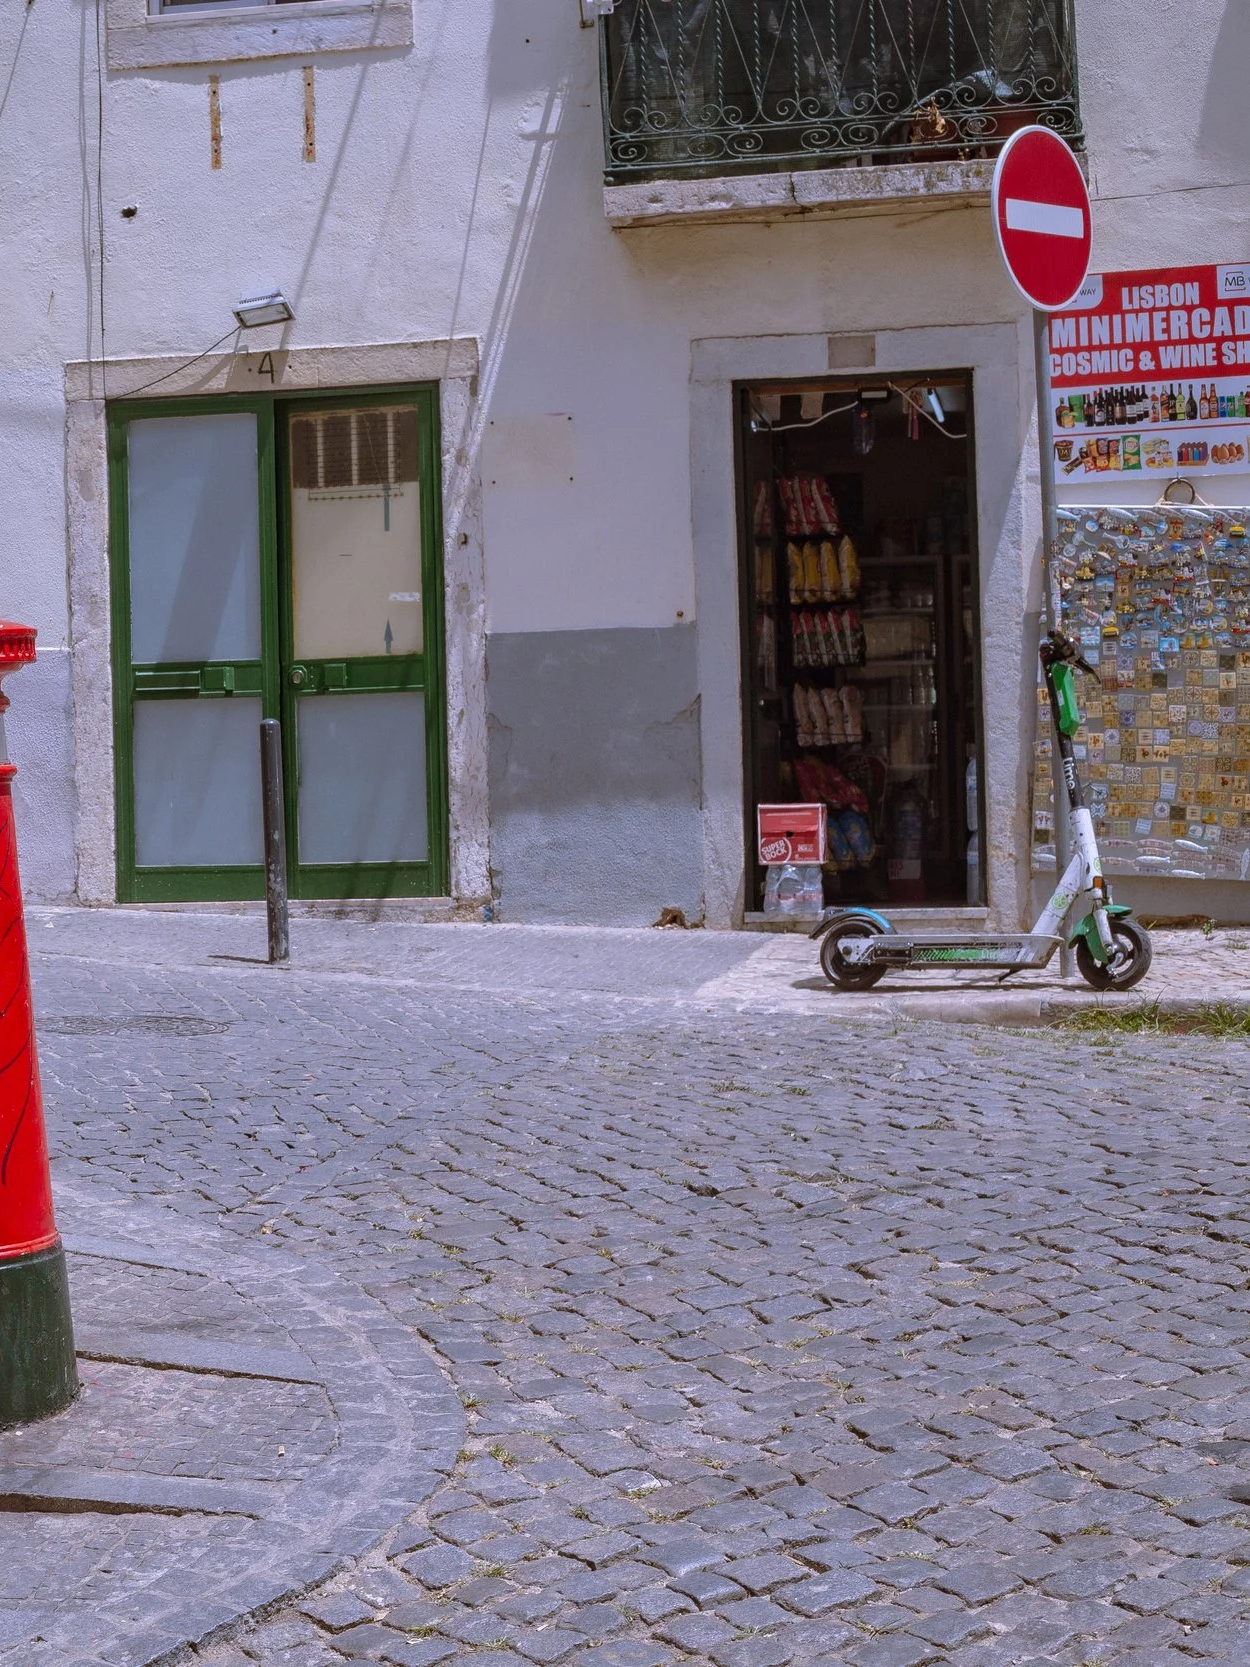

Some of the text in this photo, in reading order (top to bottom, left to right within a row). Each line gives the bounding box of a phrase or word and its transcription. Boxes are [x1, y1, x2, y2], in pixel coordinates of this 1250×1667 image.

[1079, 288, 1097, 297] WAY
[1224, 275, 1246, 288] MB
[1121, 281, 1200, 311] LISBON
[257, 351, 276, 385] 4
[1049, 348, 1135, 378] COSMIC
[1138, 350, 1156, 372] &
[1158, 342, 1218, 370] WINE
[1062, 756, 1076, 790] Lime
[761, 839, 786, 856] SUPER
[765, 846, 788, 861] BOCK
